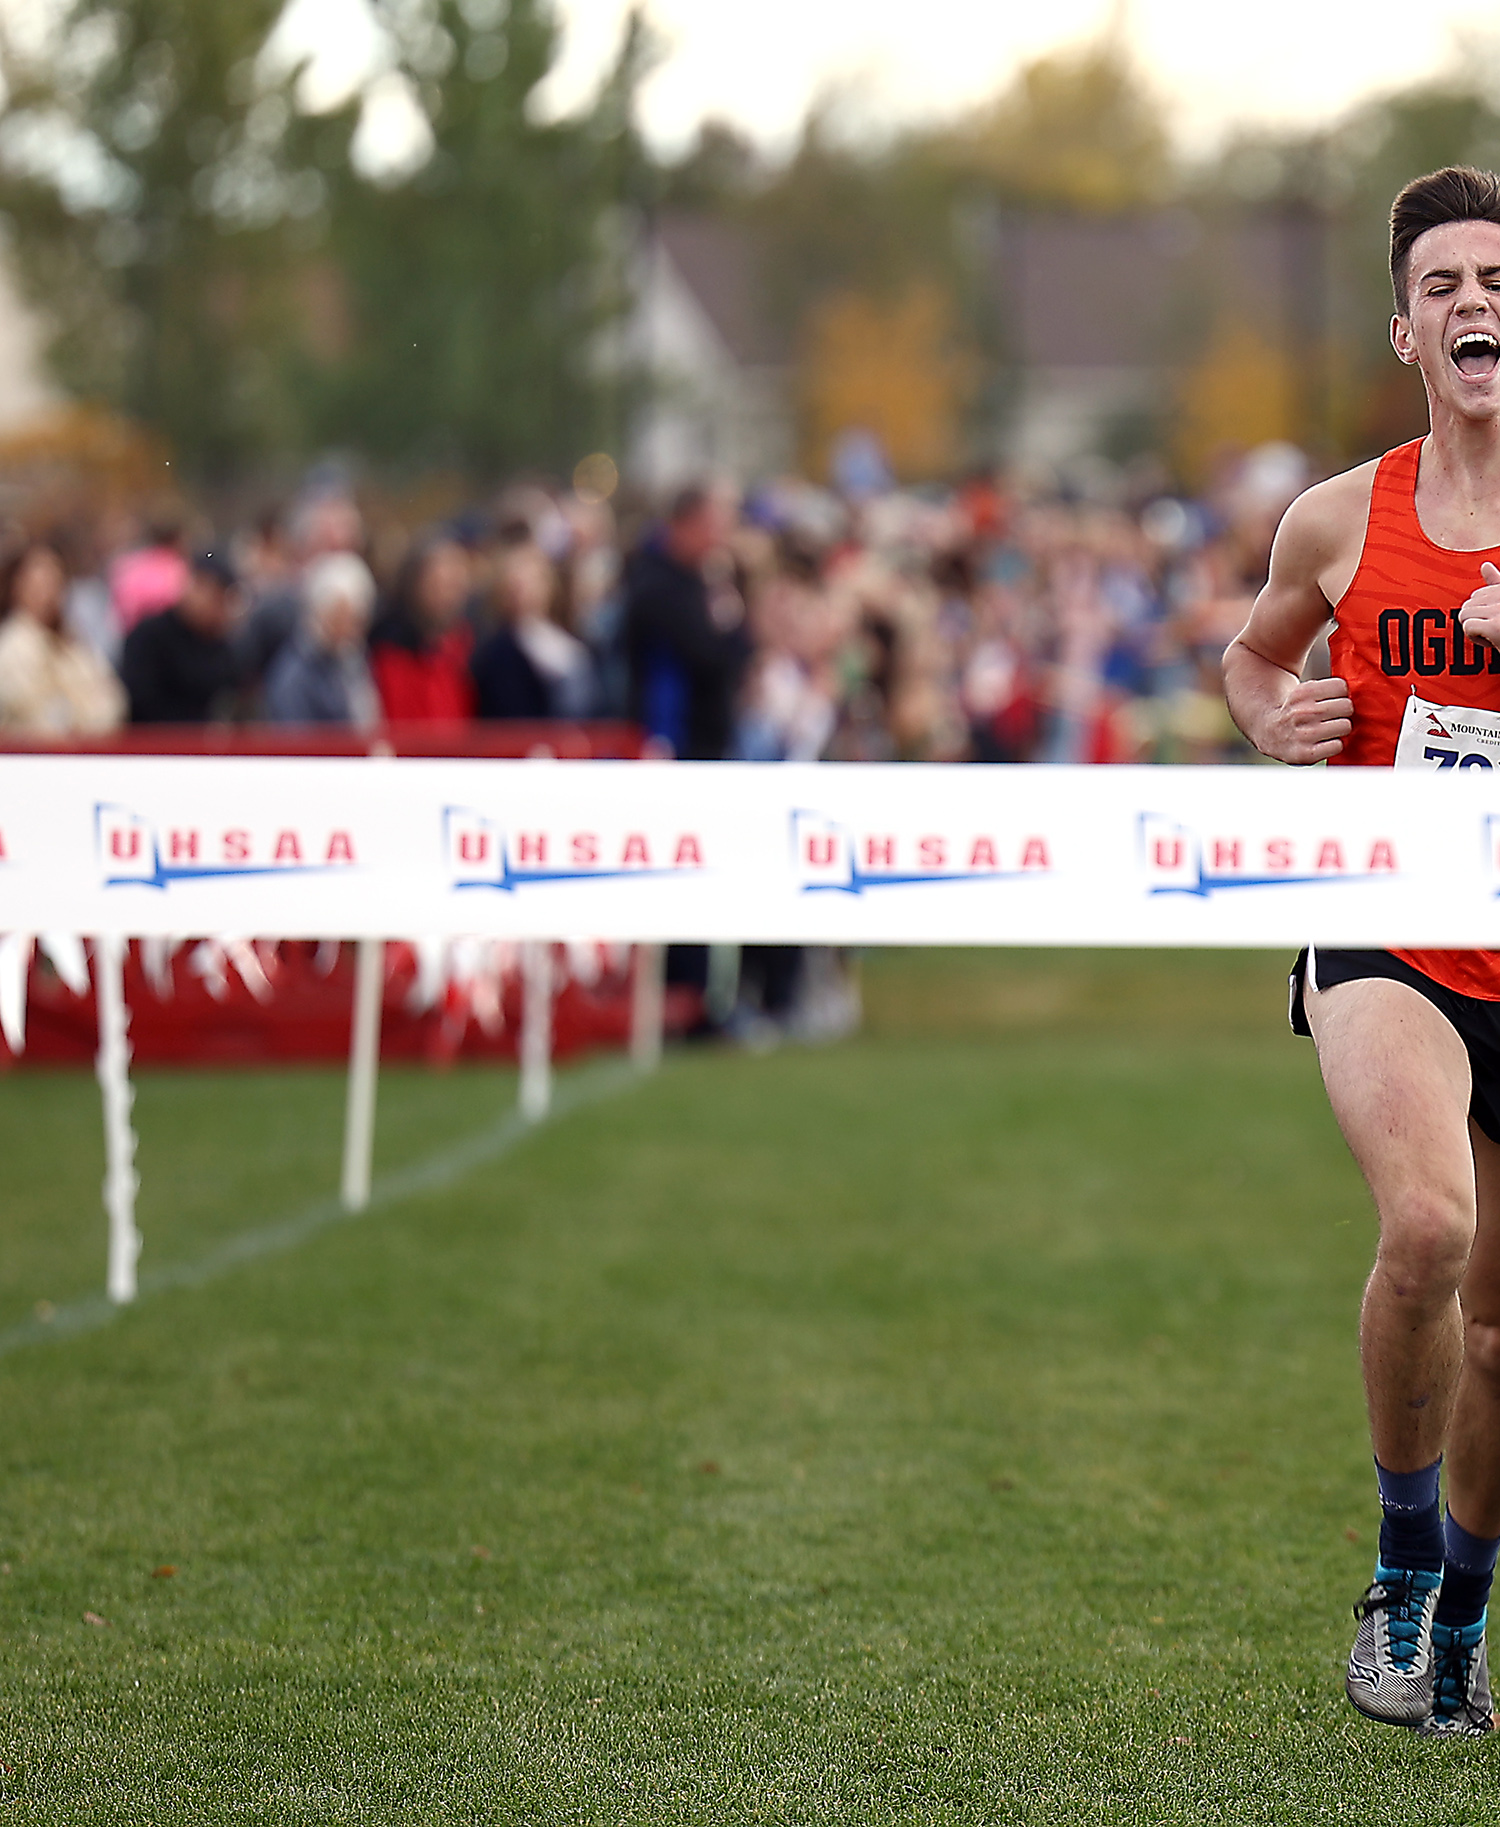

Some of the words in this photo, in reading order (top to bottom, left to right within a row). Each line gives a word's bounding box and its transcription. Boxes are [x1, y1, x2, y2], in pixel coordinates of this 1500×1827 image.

[1476, 738, 1500, 747] CREDIT
[109, 828, 356, 864] UHSAA
[457, 831, 704, 867] UHSAA
[804, 835, 1051, 871] UHSAA
[1152, 838, 1398, 873] UHSAA
